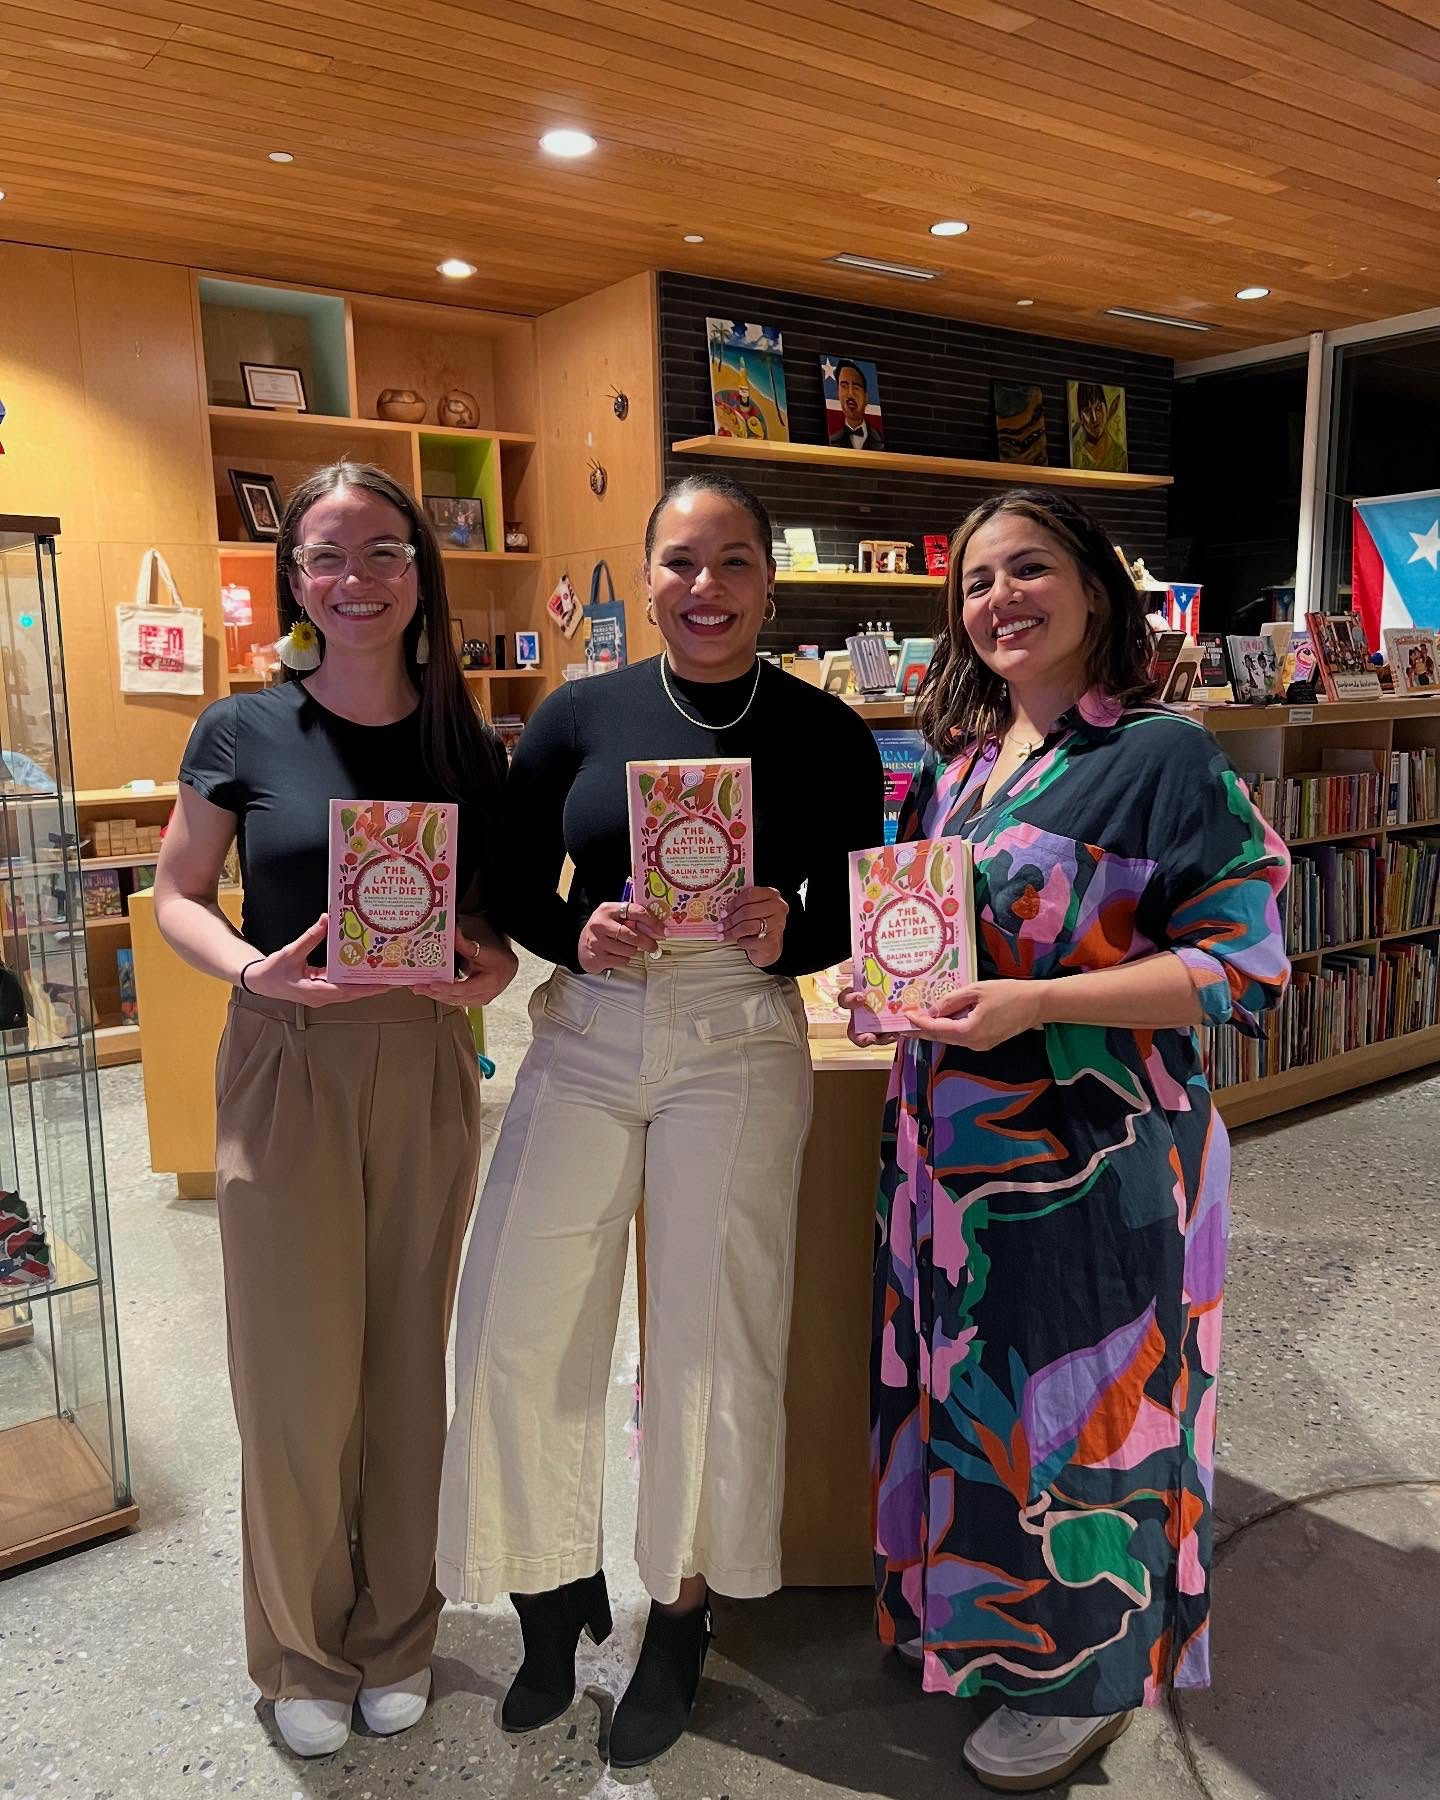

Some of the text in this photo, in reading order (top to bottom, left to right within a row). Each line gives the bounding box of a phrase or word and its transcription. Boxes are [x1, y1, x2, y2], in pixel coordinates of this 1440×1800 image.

[880, 750, 912, 761] UAL
[683, 827, 704, 835] THE
[673, 836, 714, 845] LATINA
[665, 846, 723, 855] ANTI-DIET
[384, 866, 406, 874] THE
[373, 876, 415, 885] LATINA
[363, 886, 425, 895] ANTI-DIET
[897, 907, 917, 916] THE
[889, 916, 927, 928] LATINA
[881, 925, 936, 939] ANTI-DIET
[887, 952, 912, 960] DALINA
